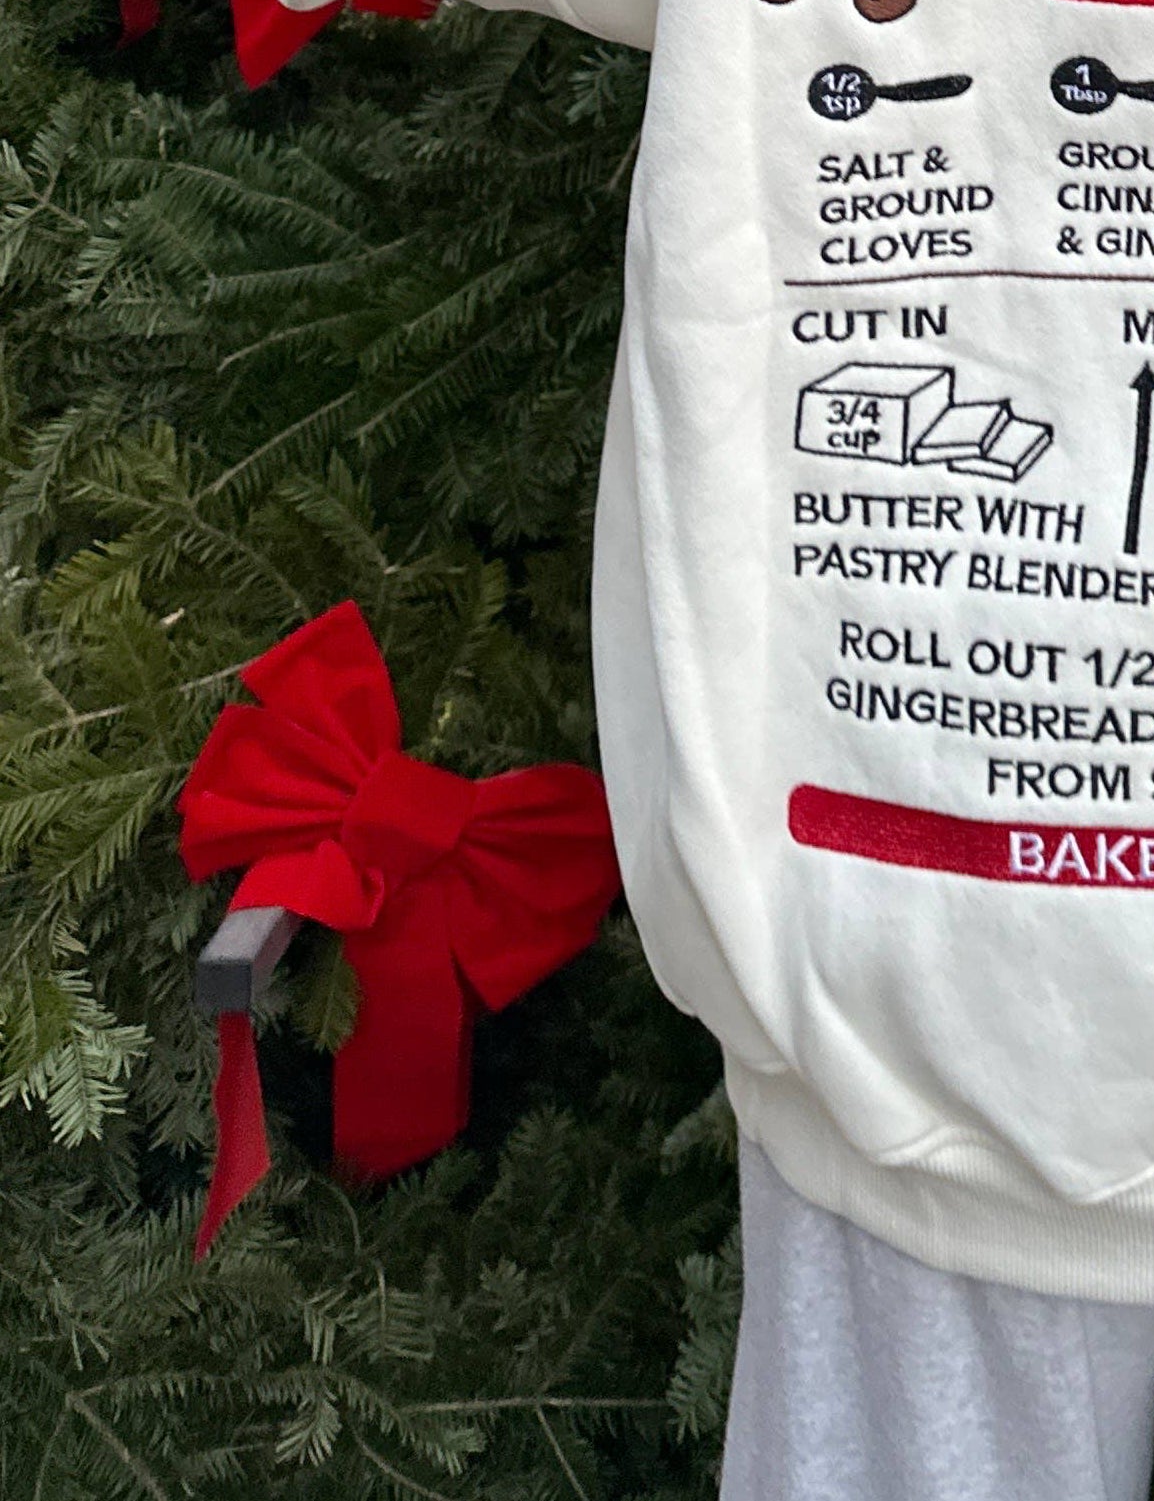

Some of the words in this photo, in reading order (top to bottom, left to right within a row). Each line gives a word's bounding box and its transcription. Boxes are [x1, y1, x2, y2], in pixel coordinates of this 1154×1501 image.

[822, 73, 861, 95] 1/2
[1075, 64, 1090, 85] 1
[822, 95, 861, 116] tsp
[1060, 85, 1107, 103] Tbsp
[819, 151, 913, 183] SALT
[924, 147, 947, 172] &
[820, 185, 993, 223] GROUND
[821, 230, 972, 264] CLOVES
[1057, 226, 1082, 254] &
[793, 310, 887, 343] CUT
[902, 306, 946, 338] IN
[828, 398, 880, 425] 3/4
[828, 430, 880, 452] cup
[795, 493, 962, 530] BUTTER
[978, 496, 1084, 543] WITH
[795, 543, 955, 586] PASTRY
[841, 621, 950, 668] ROLL
[968, 640, 1066, 682] OUT
[989, 758, 1130, 800] FROM
